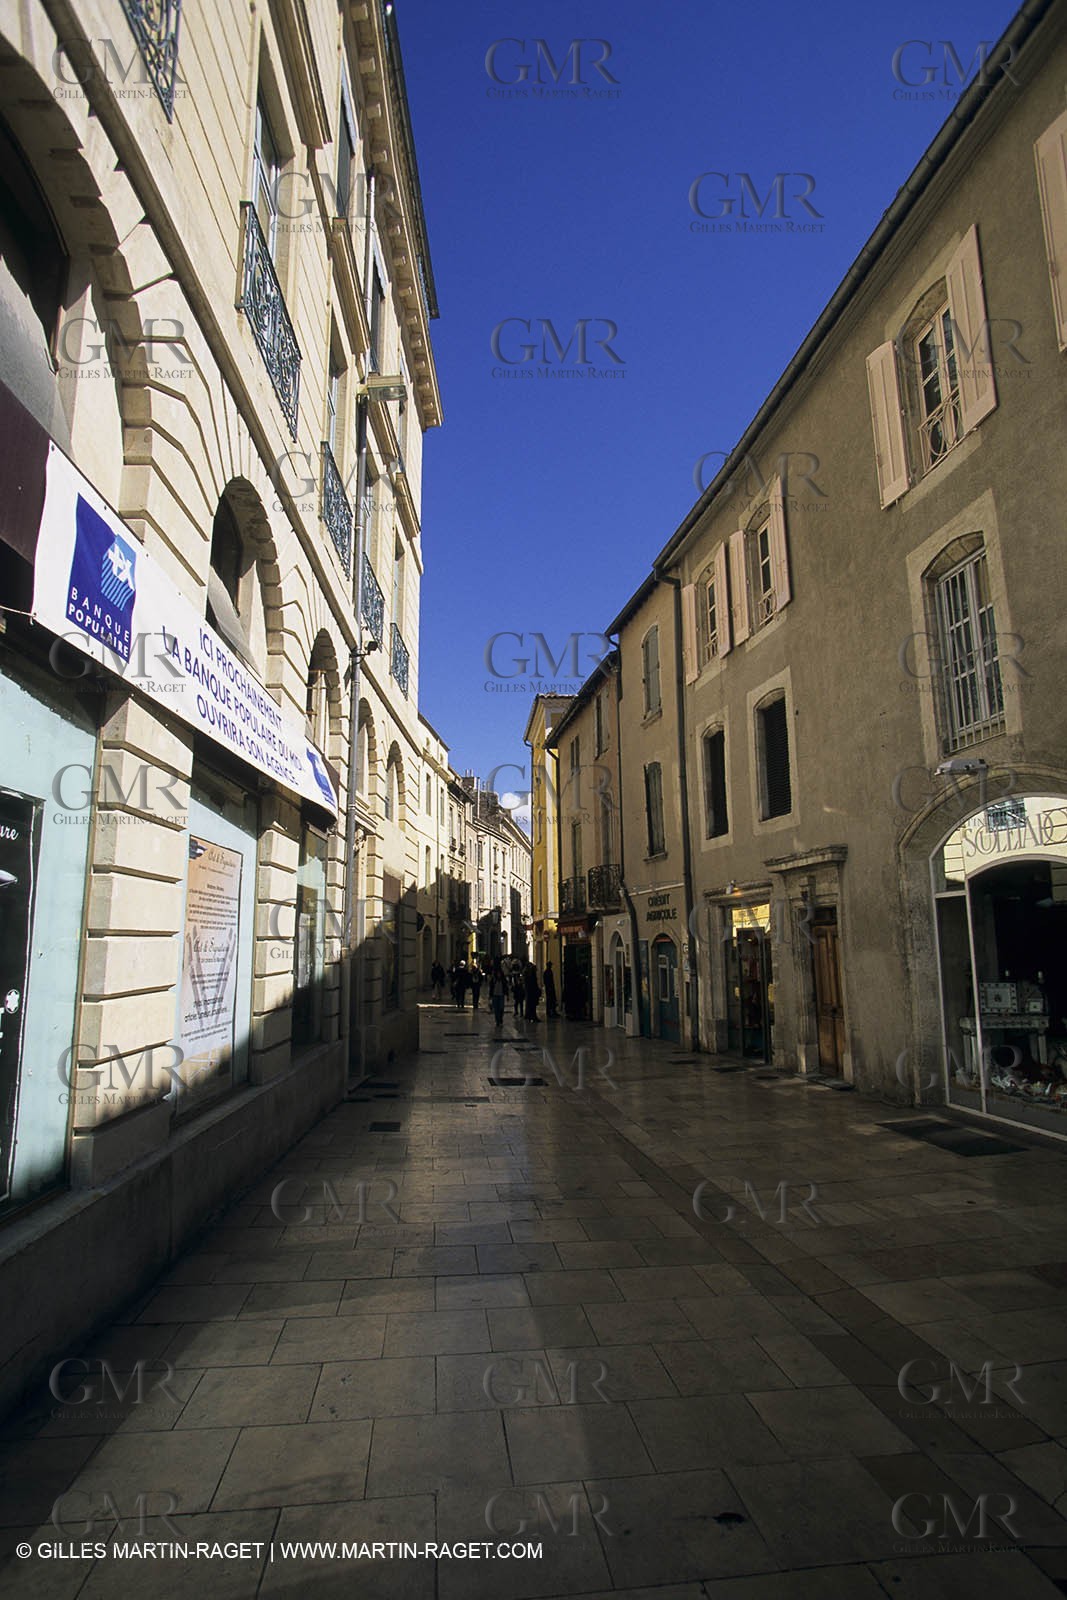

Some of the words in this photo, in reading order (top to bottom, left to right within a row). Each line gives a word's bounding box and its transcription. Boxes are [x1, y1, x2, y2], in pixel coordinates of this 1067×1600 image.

[68, 602, 129, 658] POPULAIRE
[71, 586, 130, 643] BANQUE
[162, 625, 182, 665] LA
[184, 646, 232, 711] BANQUE
[234, 695, 278, 753] POPULAIRE
[278, 739, 289, 762] DU
[199, 627, 214, 661] ICI
[216, 646, 282, 730] PROCHAINEMENT
[196, 694, 246, 752] OUVRIRA
[246, 735, 266, 766] SON
[646, 907, 677, 921] AGRICOLE
